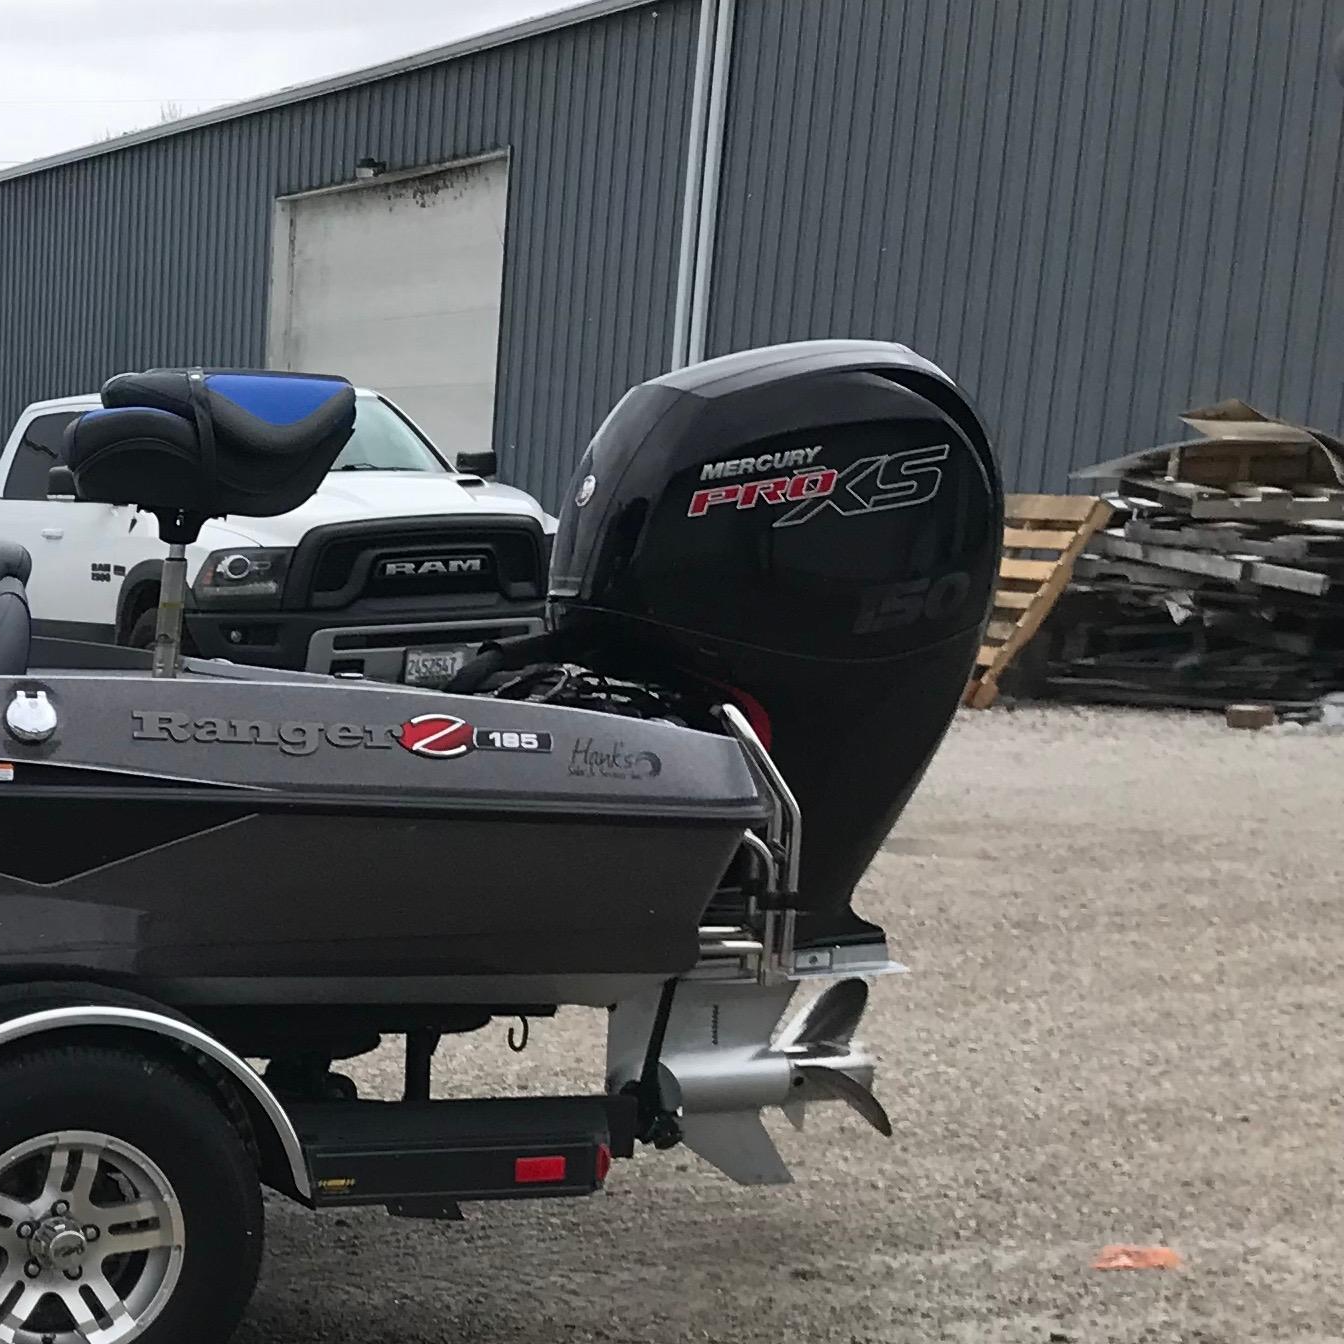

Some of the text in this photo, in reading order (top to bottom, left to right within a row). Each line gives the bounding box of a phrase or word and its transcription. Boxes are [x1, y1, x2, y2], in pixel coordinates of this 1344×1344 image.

[700, 445, 823, 480] MERCURY
[687, 468, 839, 517] PRO
[385, 559, 481, 576] RAM
[852, 571, 971, 635] 150
[131, 709, 539, 757] Ranger Z 185
[570, 737, 634, 769] Hank's
